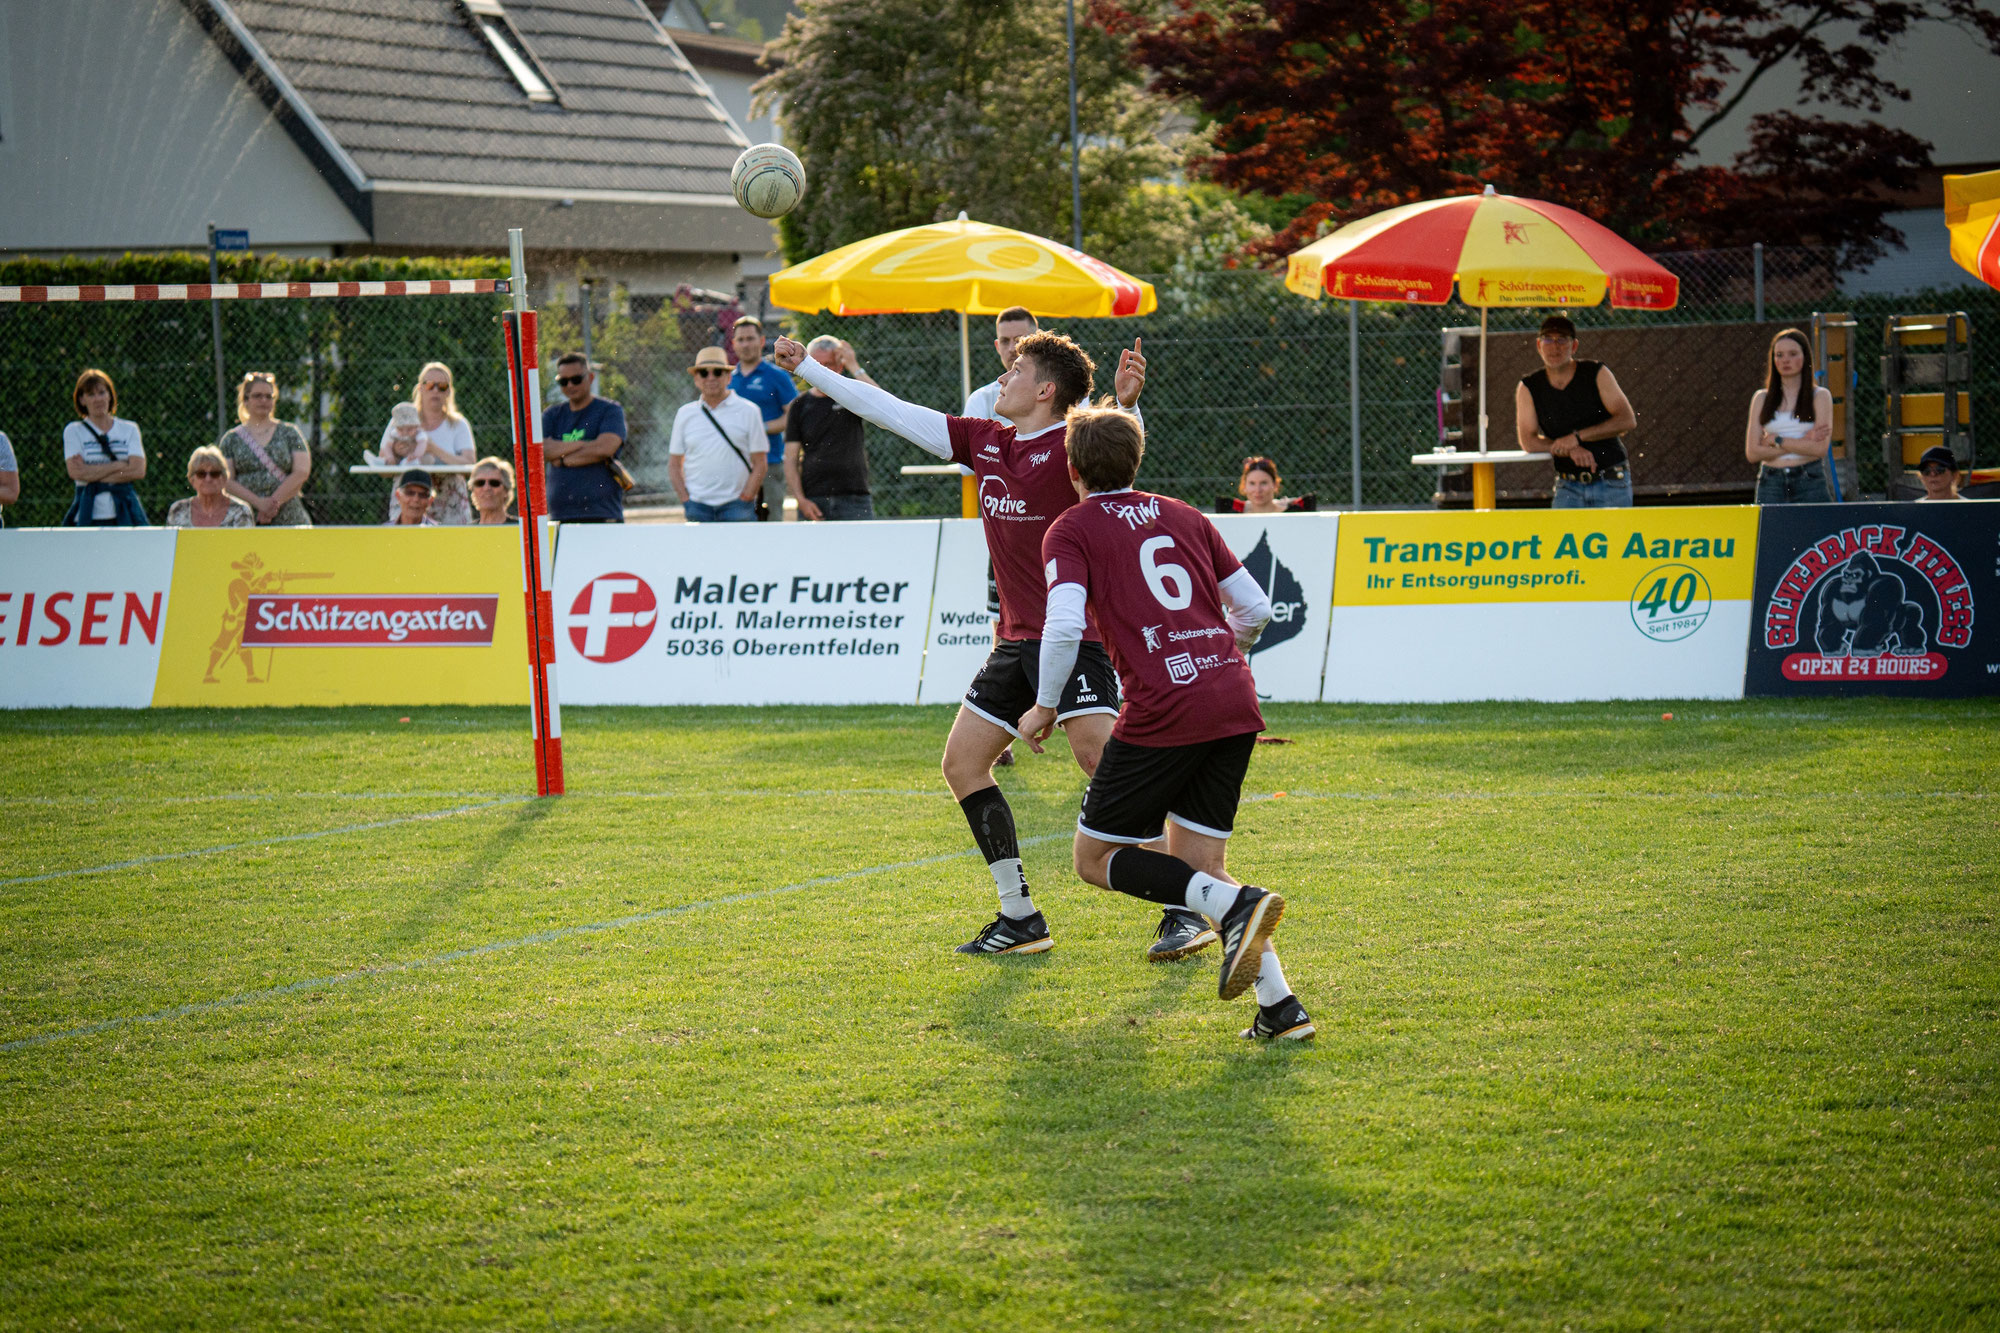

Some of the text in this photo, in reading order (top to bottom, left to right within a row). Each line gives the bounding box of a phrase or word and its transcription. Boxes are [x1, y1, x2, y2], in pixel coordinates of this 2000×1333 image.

[984, 444, 1000, 454] JAKO
[1363, 532, 1736, 567] Transport AG Aarau
[1139, 535, 1193, 611] 6
[1367, 569, 1586, 589] Ihr Entsorgungsprofi.
[674, 575, 909, 604] Maler Furter
[1637, 573, 1697, 618] 40
[1765, 524, 1975, 649] SILVERBACK FITNESS
[255, 601, 488, 641] Schützengarten
[670, 610, 905, 634] dipl. Malermeister
[940, 611, 990, 627] Wyder
[1648, 618, 1698, 635] Seit 1984
[666, 638, 900, 656] 5036 Oberentfelden
[937, 632, 992, 646] Garten
[1195, 654, 1219, 666] FMT
[1800, 658, 1931, 675] OPEN 24 HOURS
[1076, 673, 1092, 693] 1
[1076, 693, 1098, 703] JAKO
